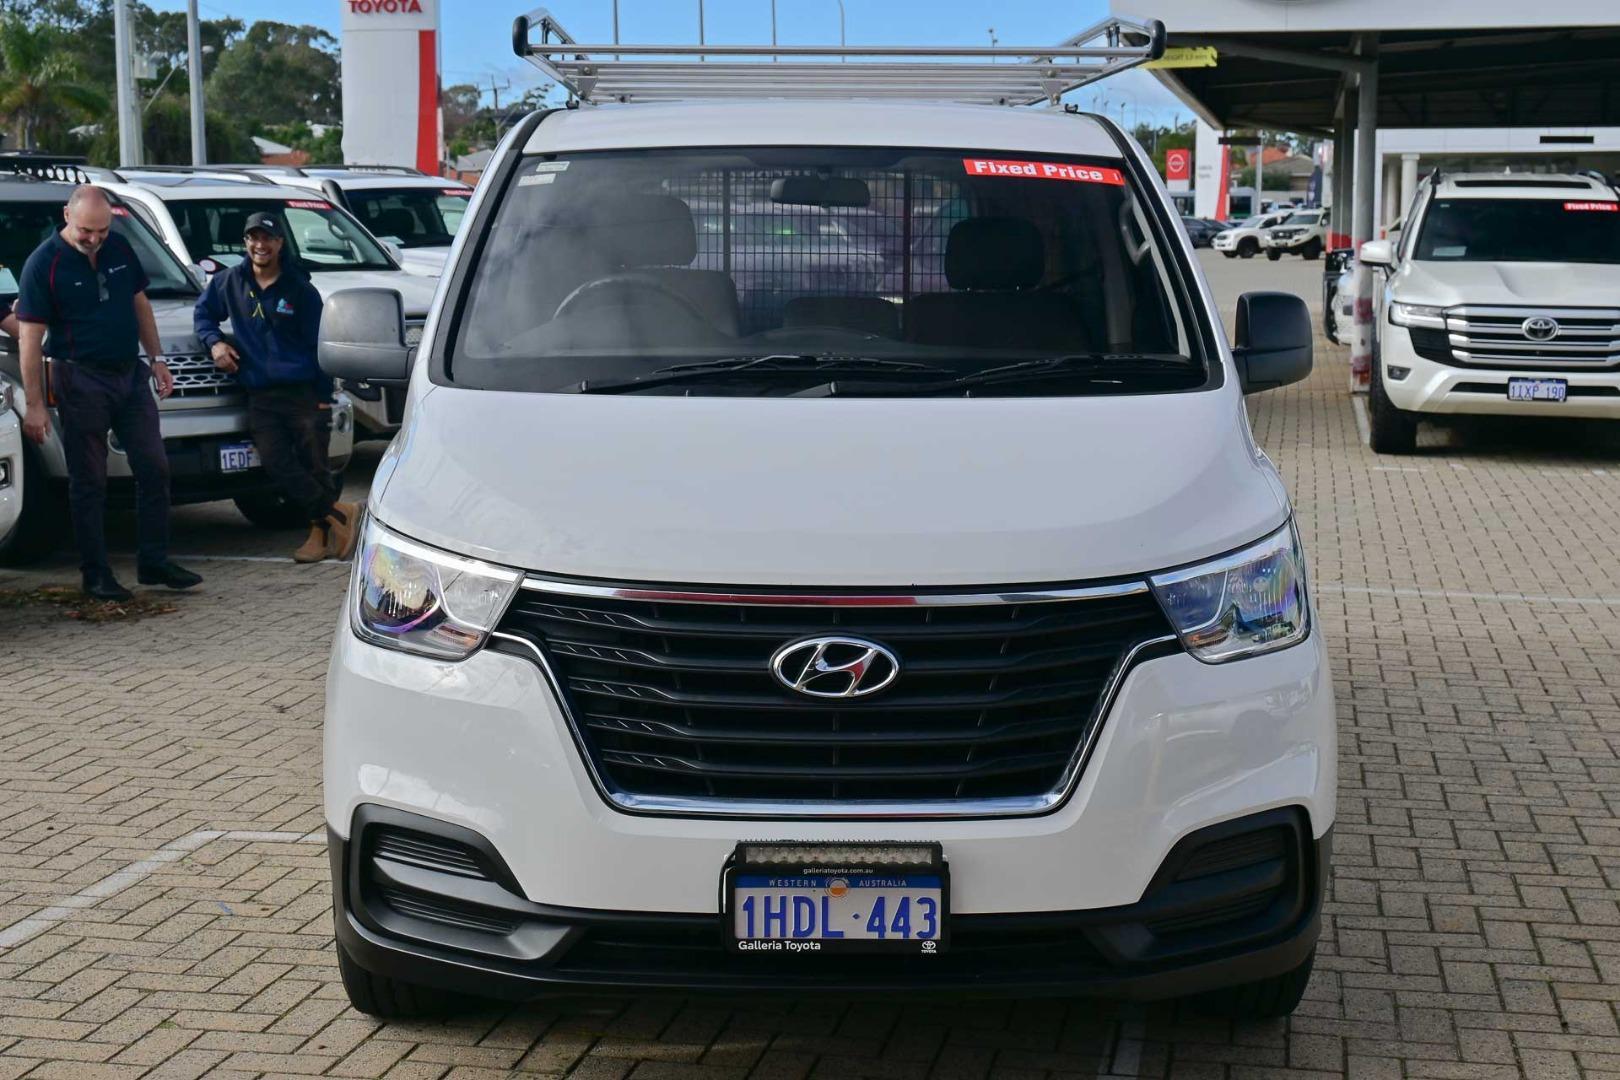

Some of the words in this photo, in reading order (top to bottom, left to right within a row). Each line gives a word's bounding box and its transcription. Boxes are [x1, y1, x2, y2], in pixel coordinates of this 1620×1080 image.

[349, 0, 422, 13] TOYOTA
[974, 161, 1037, 175] Fixed
[1043, 165, 1103, 181] Price
[1547, 386, 1565, 399] 190
[803, 867, 873, 875] galleriatoyota.com.au
[769, 879, 817, 887] WESTERN
[859, 880, 907, 888] AUSTRALIA
[742, 896, 844, 938] 1HDL
[866, 896, 937, 939] 443
[738, 940, 782, 950] Galleria
[784, 940, 821, 953] Toyota
